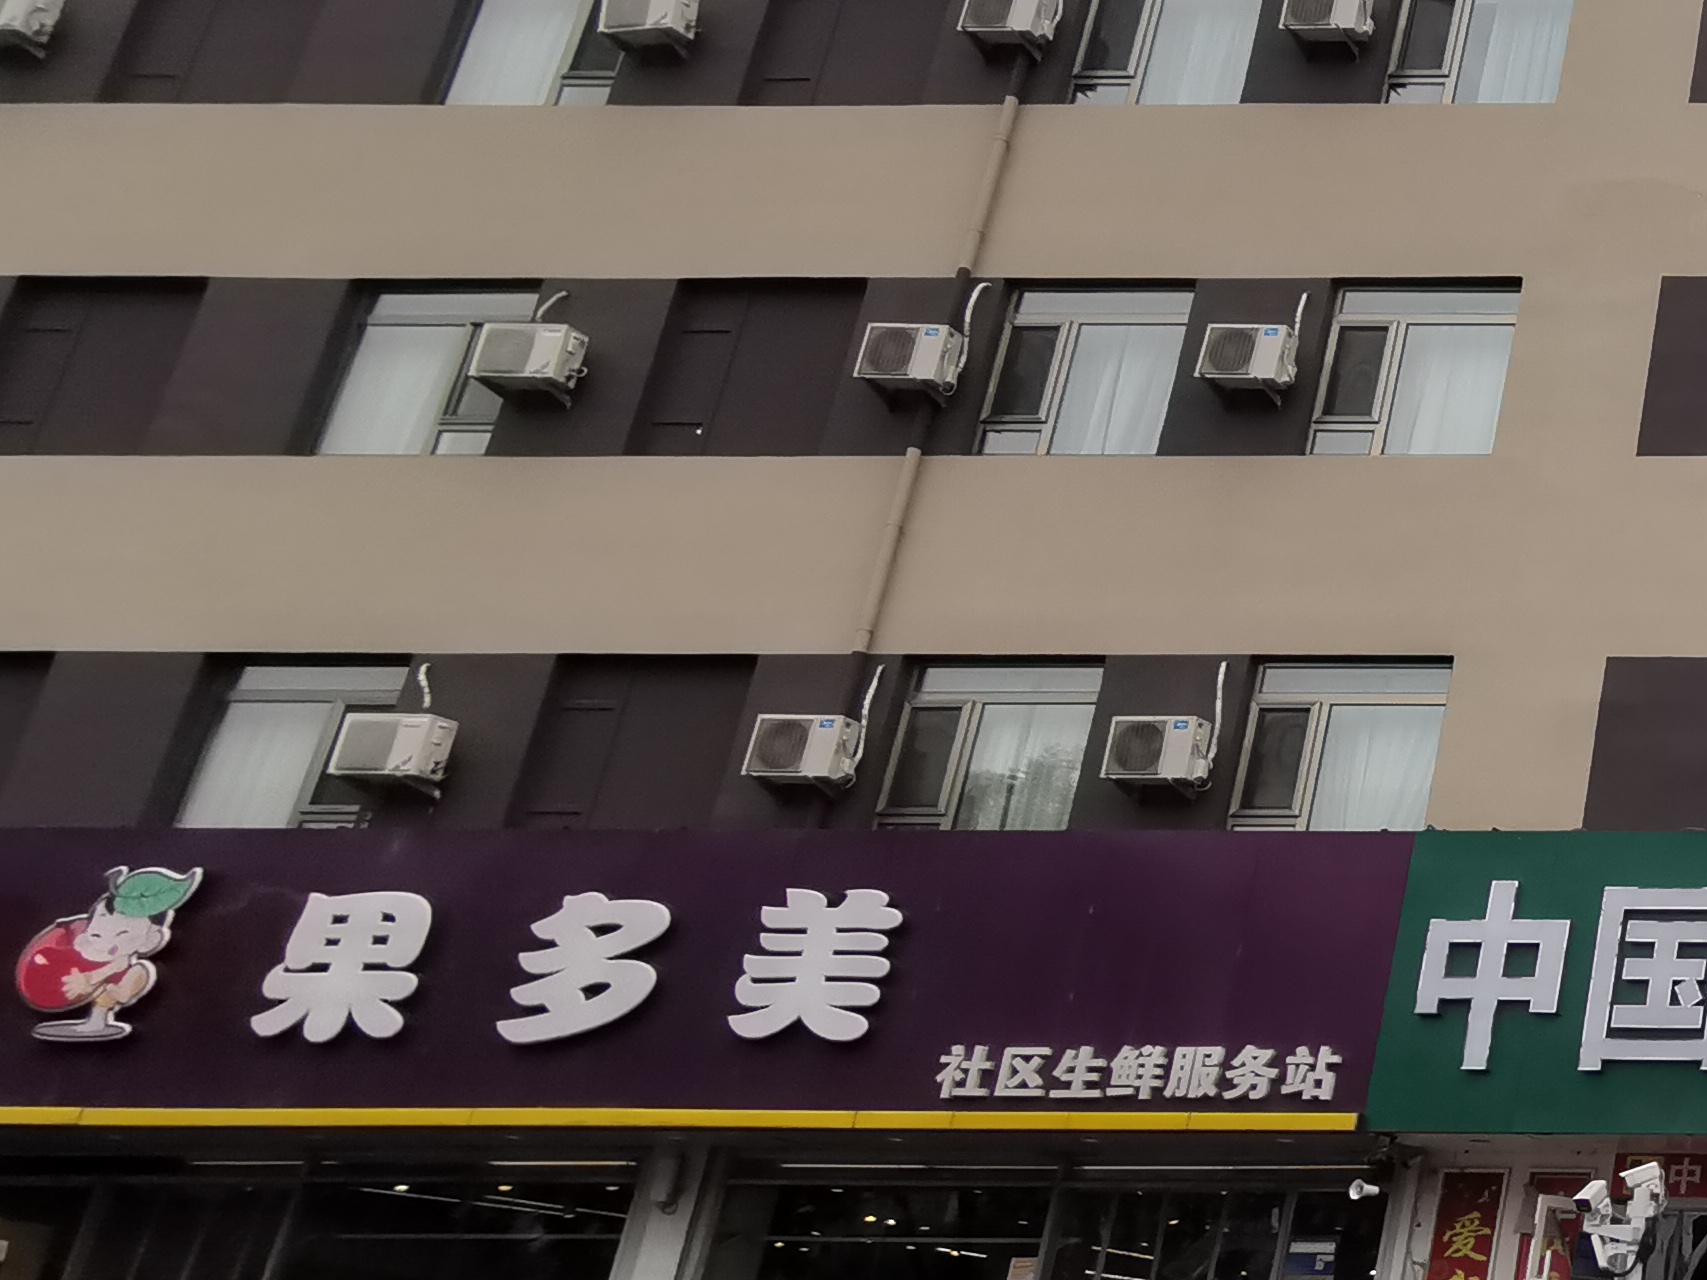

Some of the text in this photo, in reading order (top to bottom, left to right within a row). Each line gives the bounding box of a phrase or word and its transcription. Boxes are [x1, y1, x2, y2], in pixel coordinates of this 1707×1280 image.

[250, 887, 903, 1044] 果多美
[935, 1043, 1343, 1100] 社区生鲜服务站
